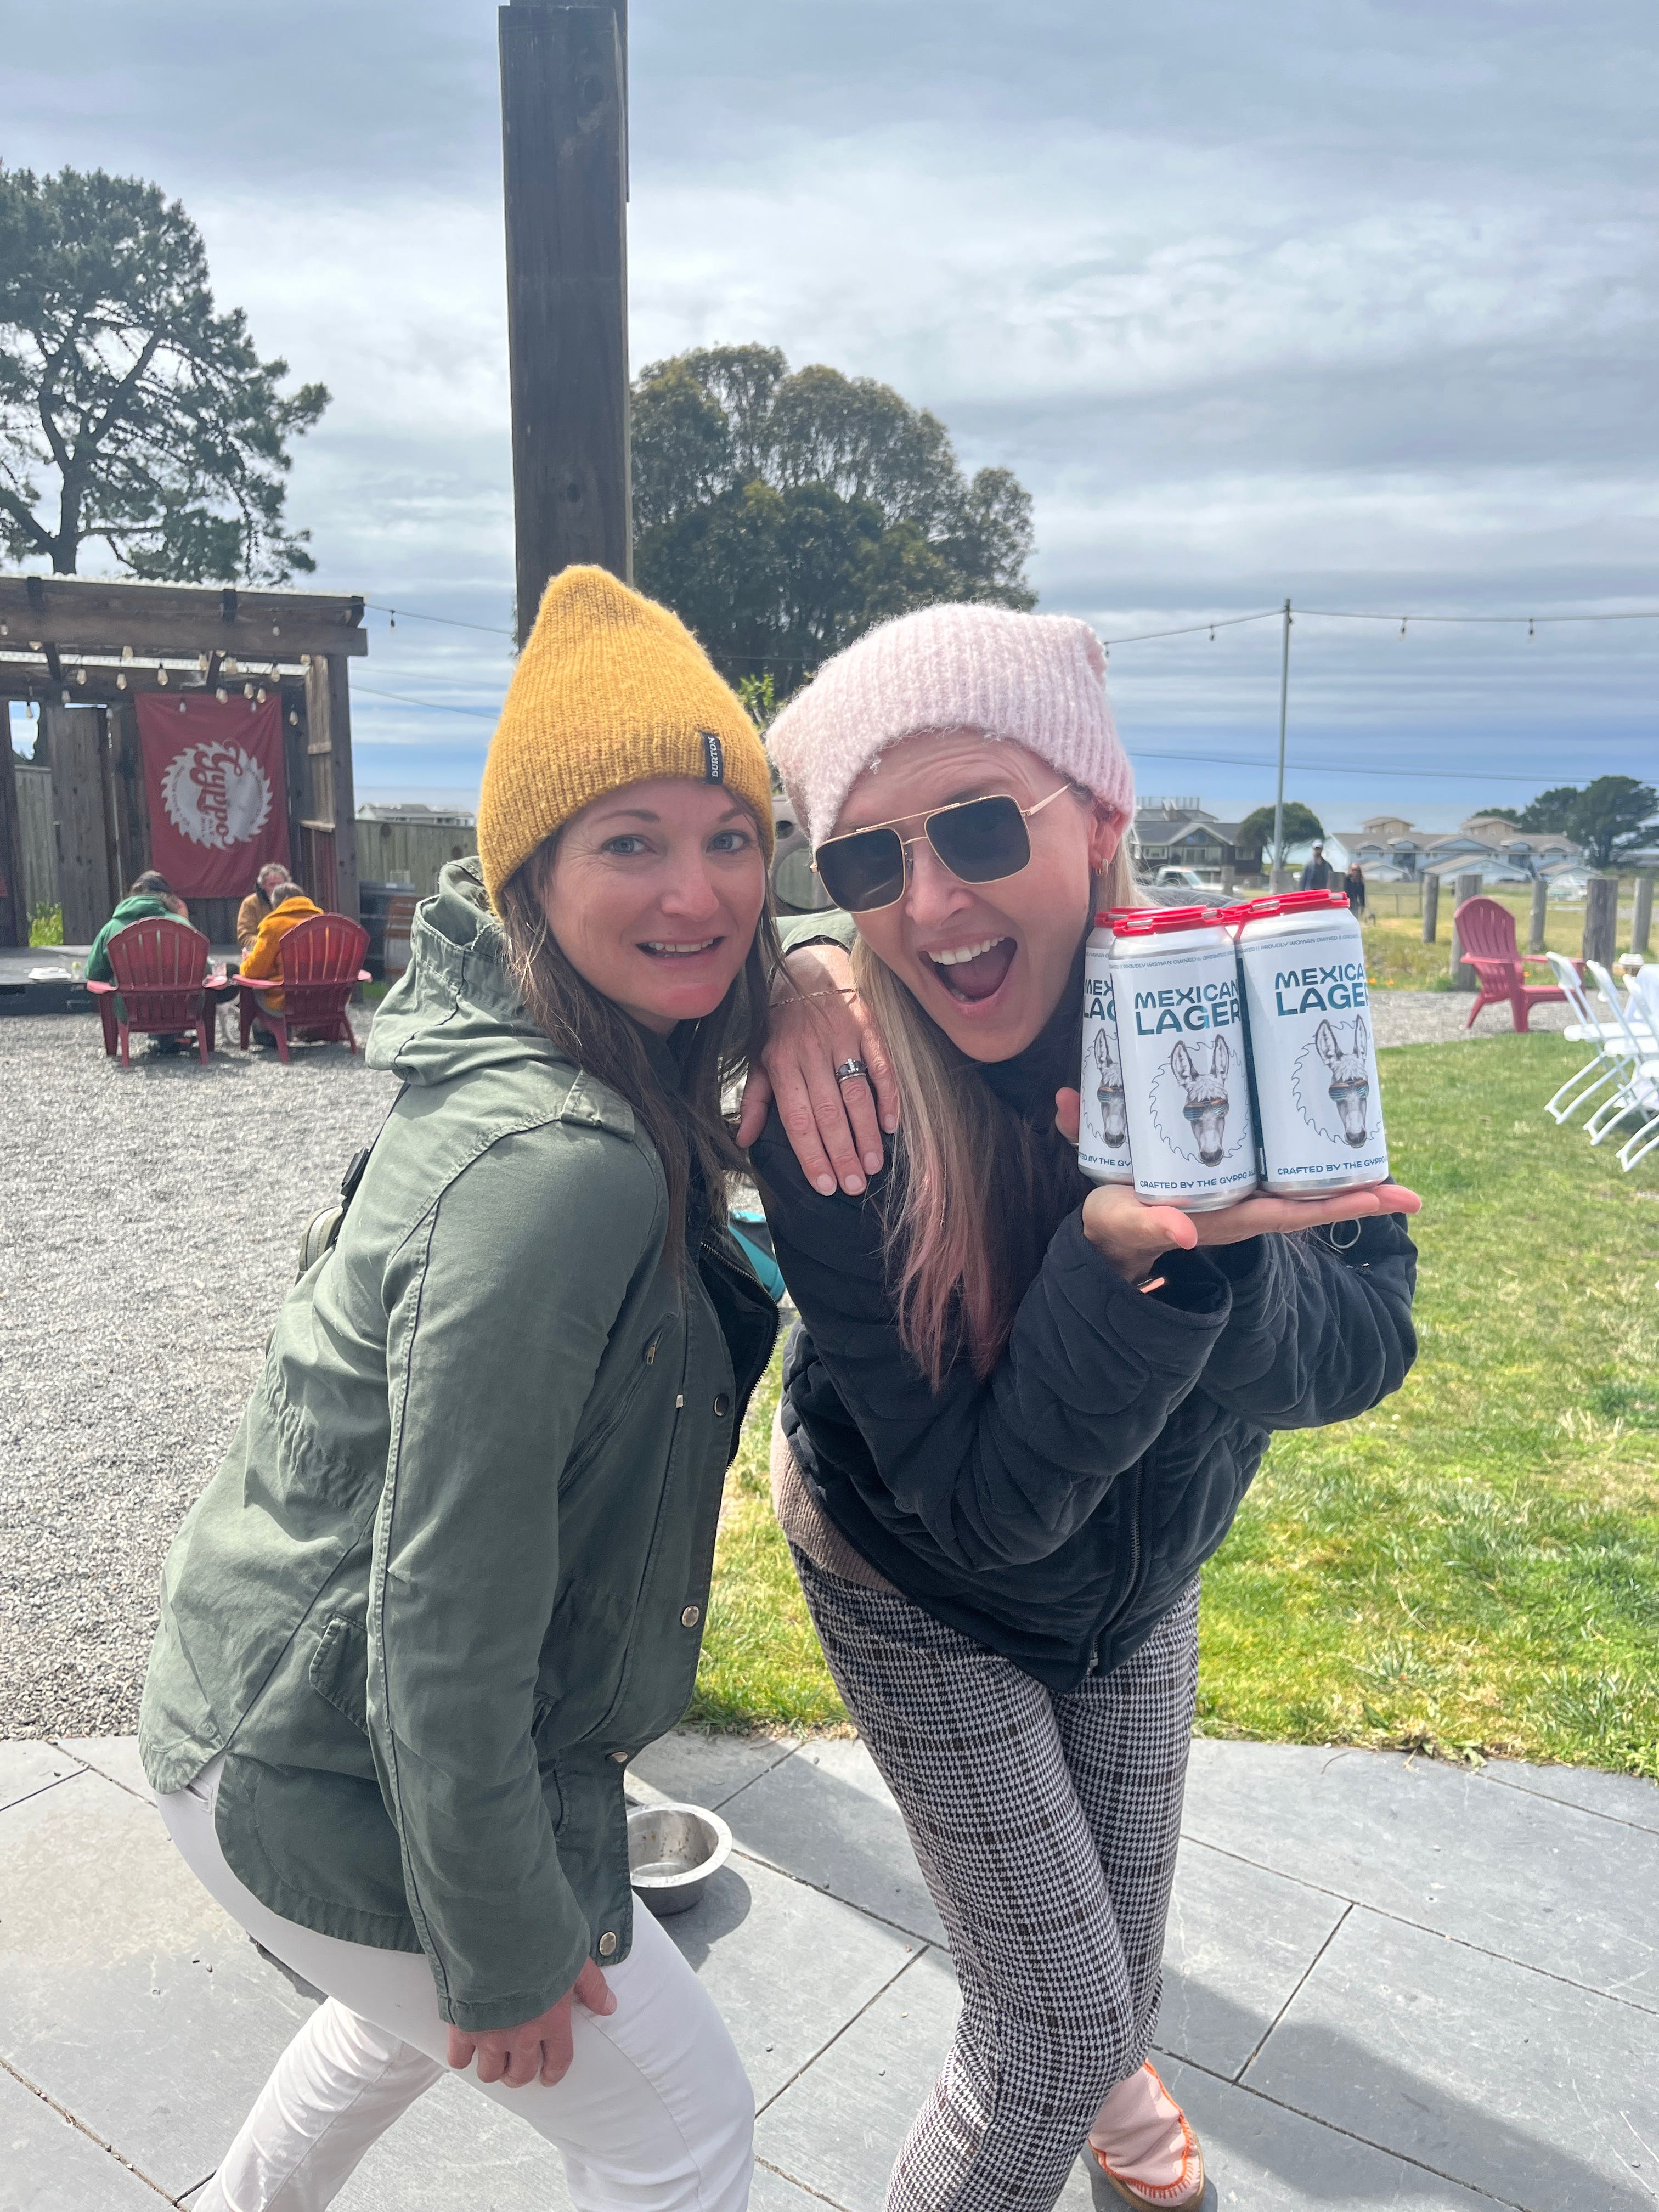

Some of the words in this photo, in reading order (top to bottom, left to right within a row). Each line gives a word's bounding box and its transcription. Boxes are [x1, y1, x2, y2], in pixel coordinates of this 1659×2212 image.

[708, 737, 719, 777] BURTON
[190, 738, 243, 847] Gyppo
[1135, 979, 1238, 1009] MEXICAN
[1135, 999, 1242, 1035] LAGER
[1140, 1180, 1177, 1189] CRAFTED
[1196, 1178, 1217, 1187] THE
[1219, 1172, 1247, 1184] GYPPO
[1277, 1165, 1323, 1175] CRAFTED
[1343, 1160, 1362, 1170] THE
[1364, 1156, 1385, 1166] GYPPO
